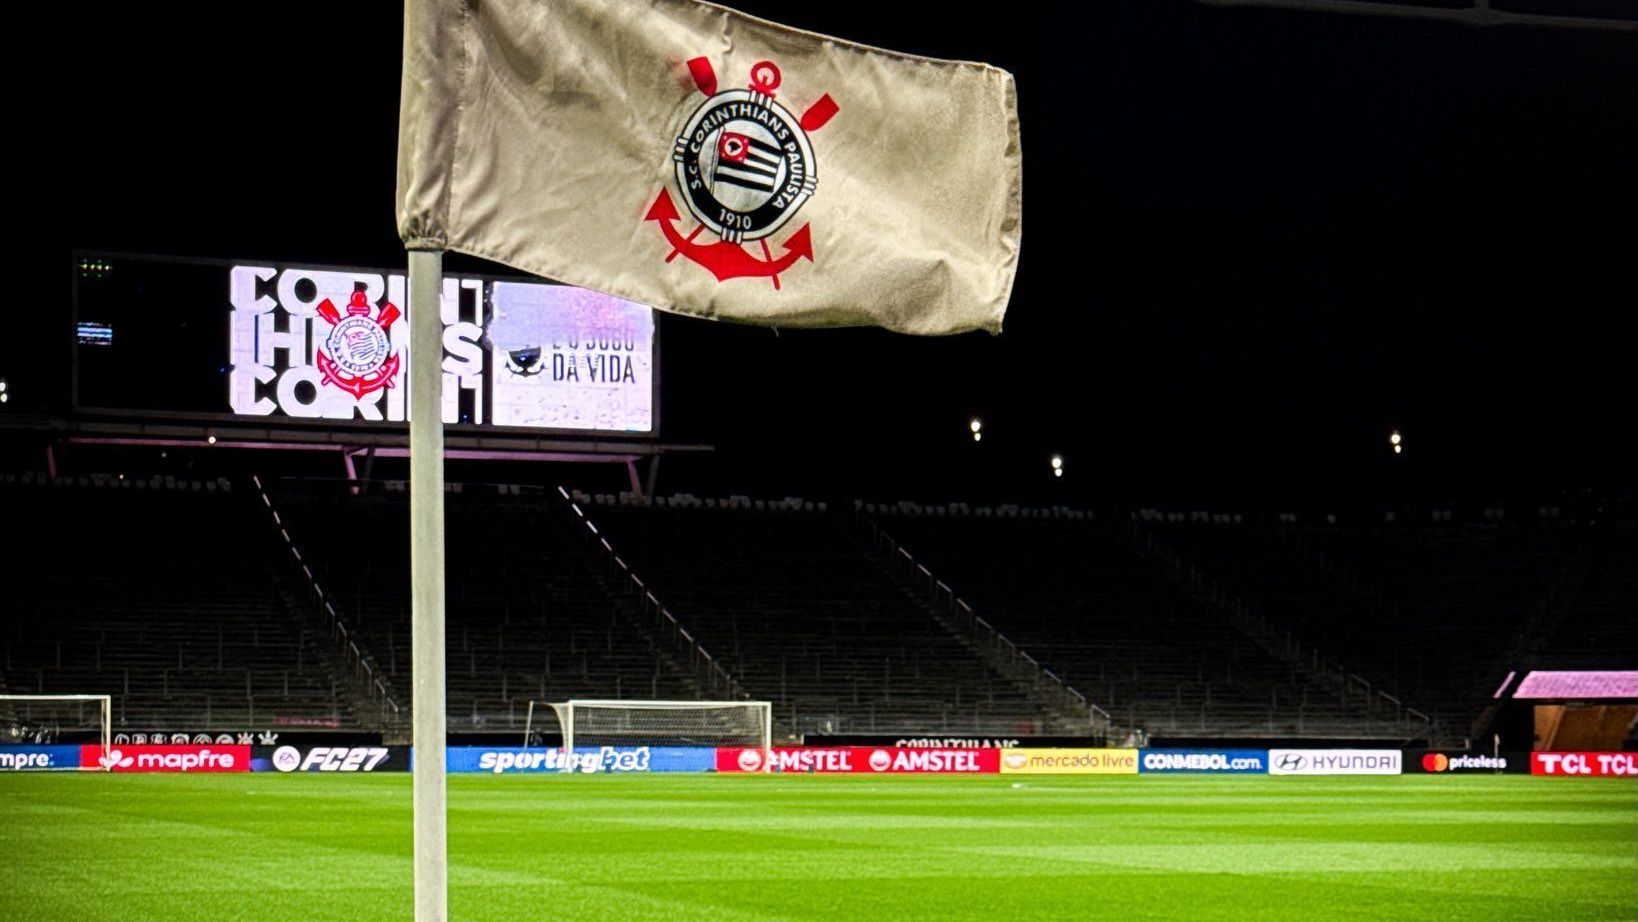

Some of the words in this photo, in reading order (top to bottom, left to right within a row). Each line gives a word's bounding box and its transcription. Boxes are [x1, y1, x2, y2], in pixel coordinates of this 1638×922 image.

[691, 103, 790, 154] CORINTHIANS
[771, 142, 803, 209] PAULISTA
[718, 207, 752, 230] 1910
[552, 353, 579, 382] DA
[587, 353, 636, 384] VIDA
[137, 749, 235, 772] mapfre
[299, 747, 389, 771] FC27
[478, 746, 651, 773] sportingbet
[892, 750, 979, 771] AMSTEL
[1030, 753, 1099, 768] mercado
[1102, 754, 1134, 768] livre
[1312, 755, 1397, 770] HYUNDAI
[1448, 755, 1507, 771] priceless
[1537, 753, 1592, 774] TCL
[1597, 753, 1638, 775] TCL
